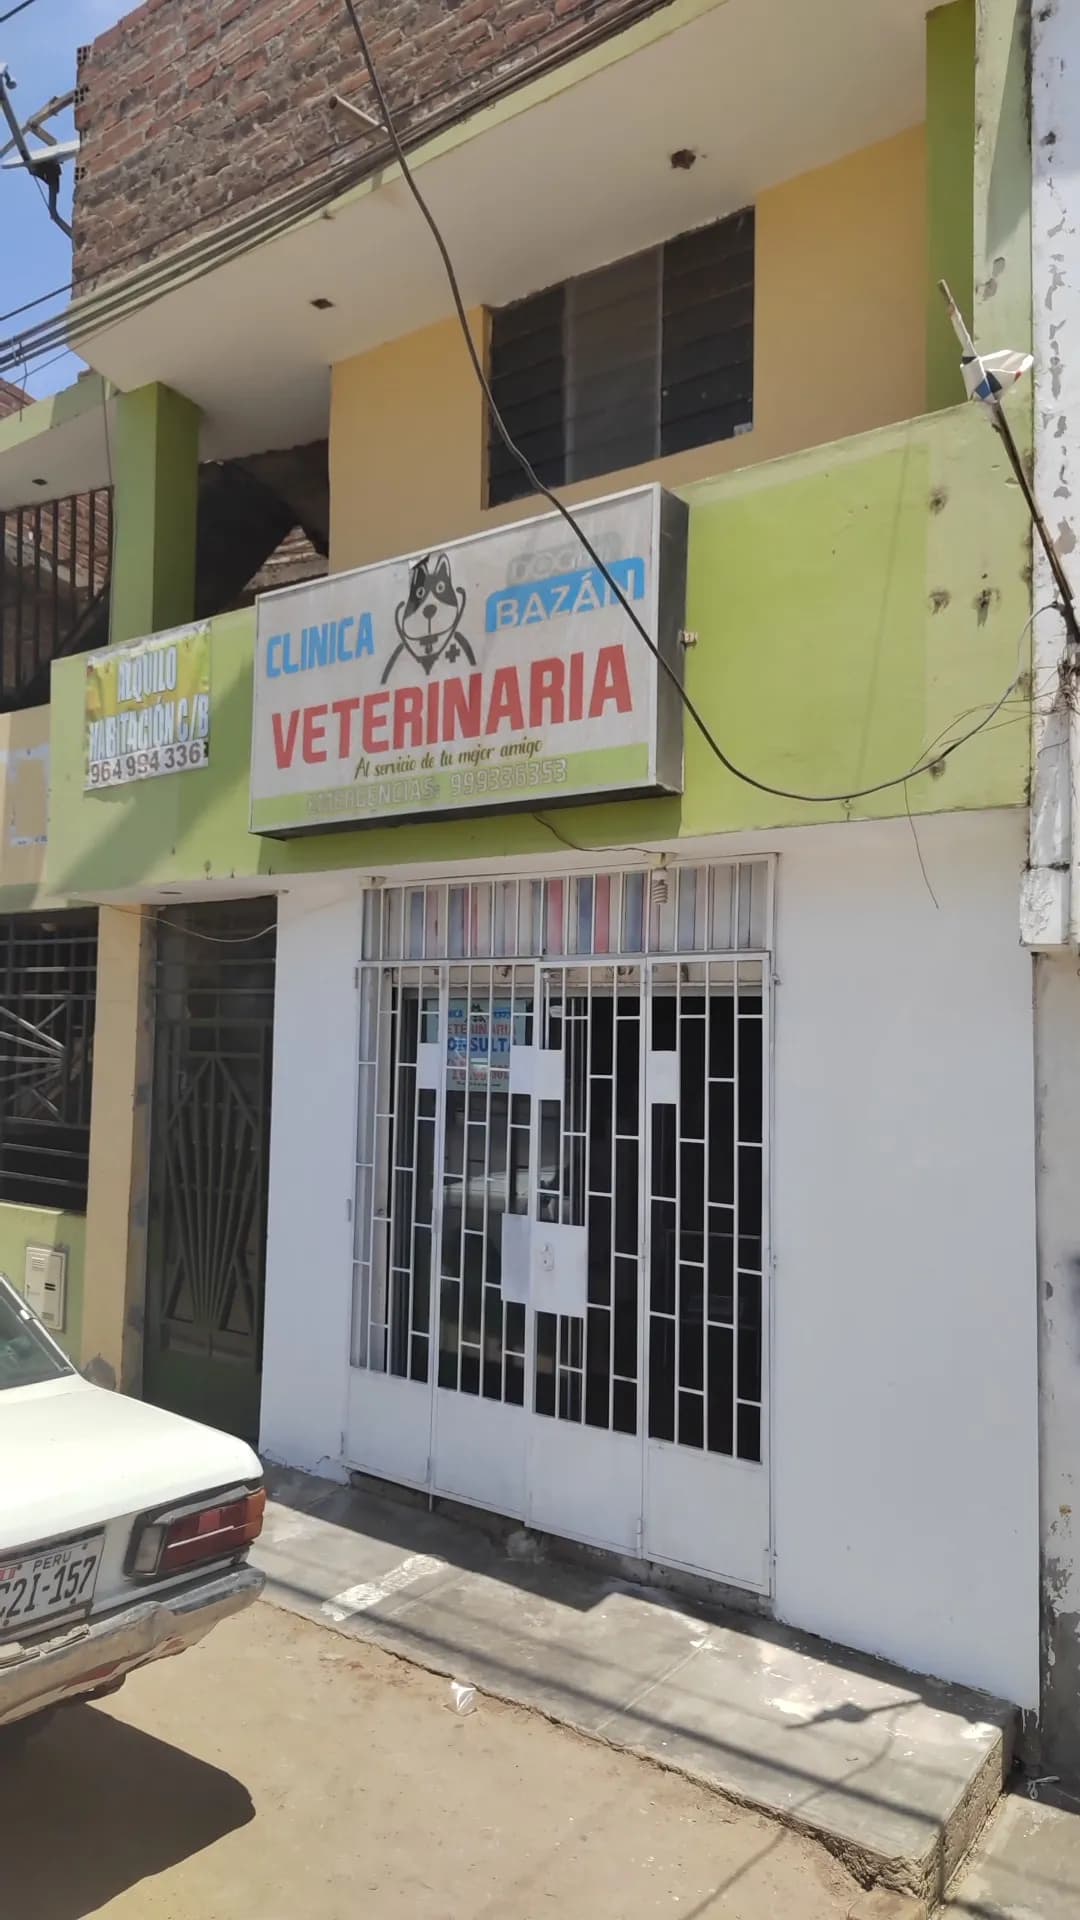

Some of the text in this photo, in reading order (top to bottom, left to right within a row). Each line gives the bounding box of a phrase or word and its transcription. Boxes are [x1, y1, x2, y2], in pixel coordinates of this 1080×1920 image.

[496, 568, 635, 630] BAZÁN
[266, 612, 375, 679] CLINICA
[272, 645, 633, 769] VETERINARIA
[91, 760, 122, 784] 964
[164, 742, 201, 769] 336
[354, 736, 543, 780] Al servicio de tu mejor amigo
[450, 758, 569, 796] 999336353
[33, 1551, 72, 1573] PERU
